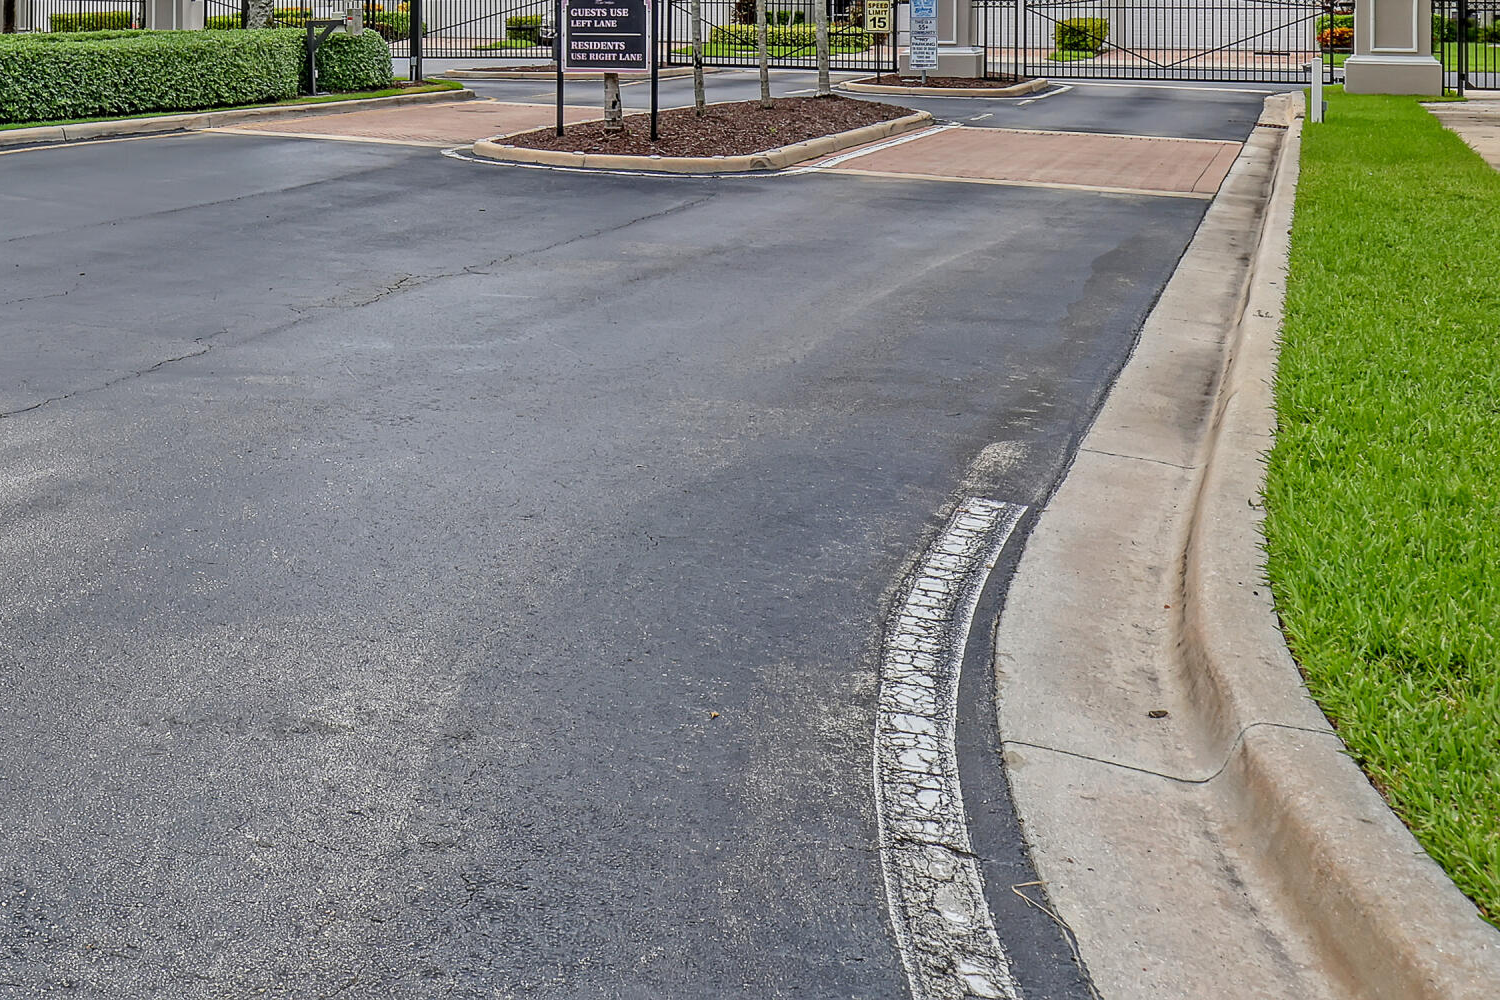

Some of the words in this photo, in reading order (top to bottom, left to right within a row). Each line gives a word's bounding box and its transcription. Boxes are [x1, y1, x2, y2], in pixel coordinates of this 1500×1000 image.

[570, 8, 607, 17] GUESTS
[610, 8, 629, 17] USE
[571, 20, 592, 28] LEFT
[594, 20, 618, 28] LANE
[870, 17, 887, 29] 15
[571, 41, 626, 50] RESIDENTS
[589, 53, 618, 61] RIGHT
[619, 53, 643, 61] LANE
